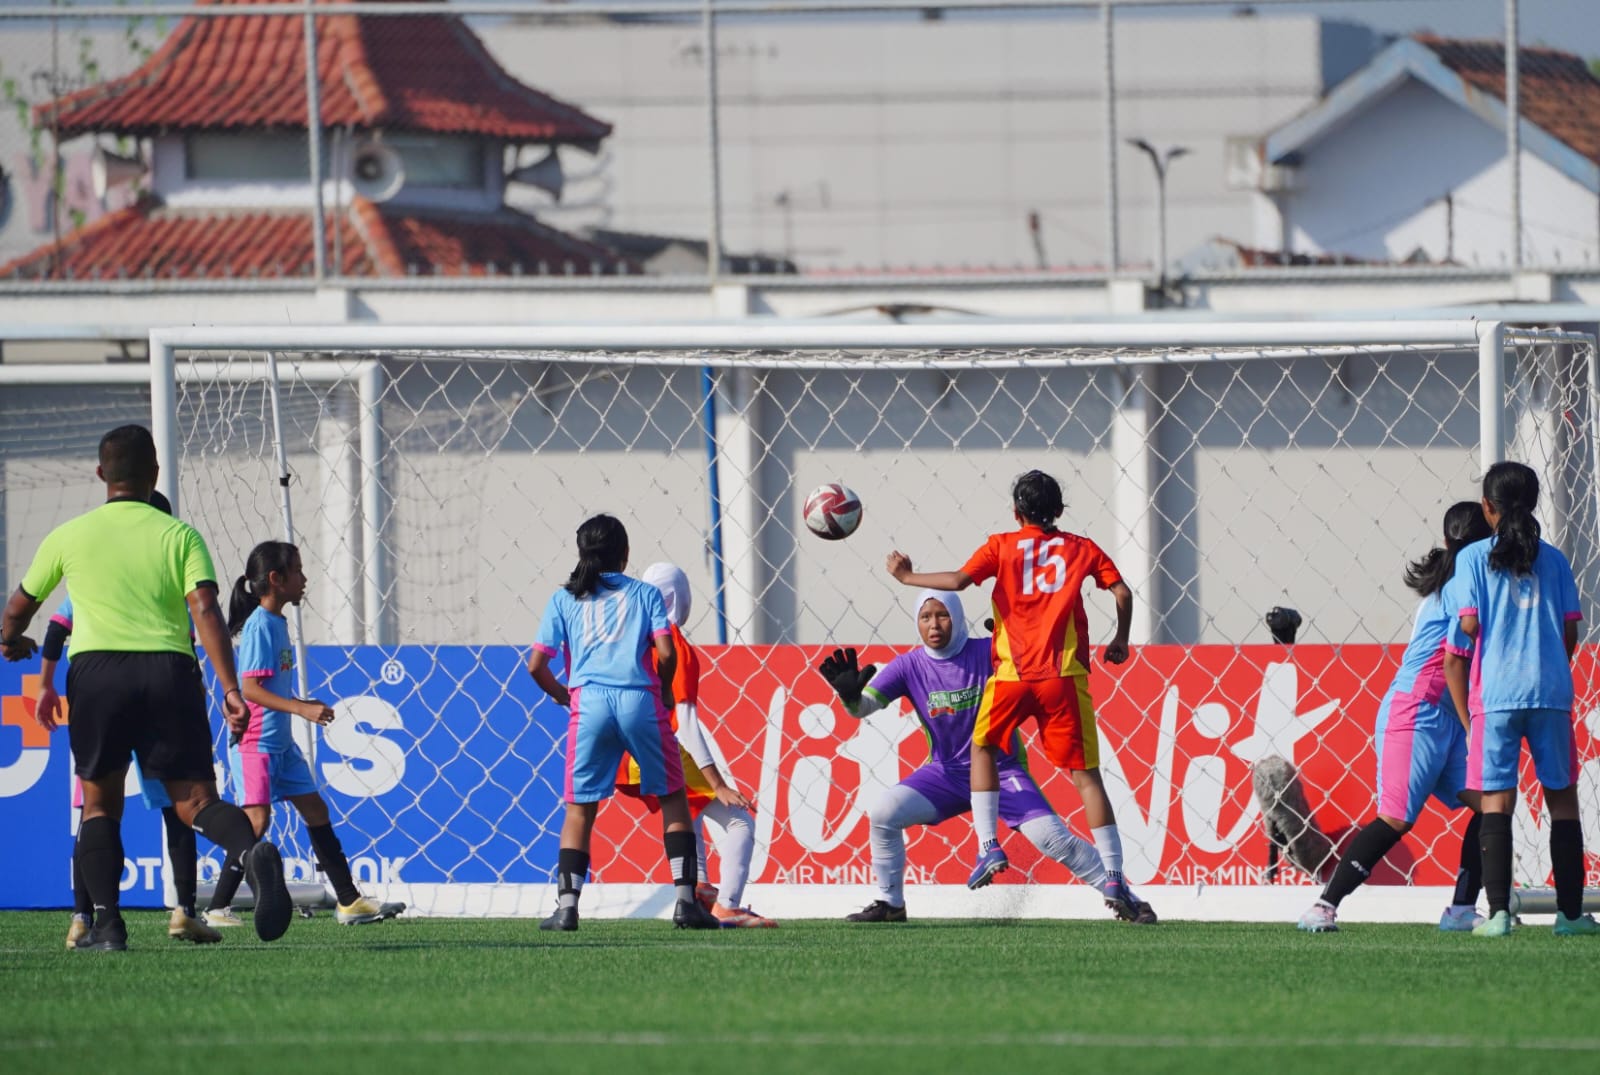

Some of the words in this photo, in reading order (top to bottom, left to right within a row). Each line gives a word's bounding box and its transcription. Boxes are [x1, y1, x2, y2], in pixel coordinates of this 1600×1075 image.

[1016, 537, 1067, 595] 15
[582, 590, 628, 647] 10
[1008, 776, 1023, 792] 1
[773, 865, 816, 884] AIR
[1167, 865, 1210, 885] AIR
